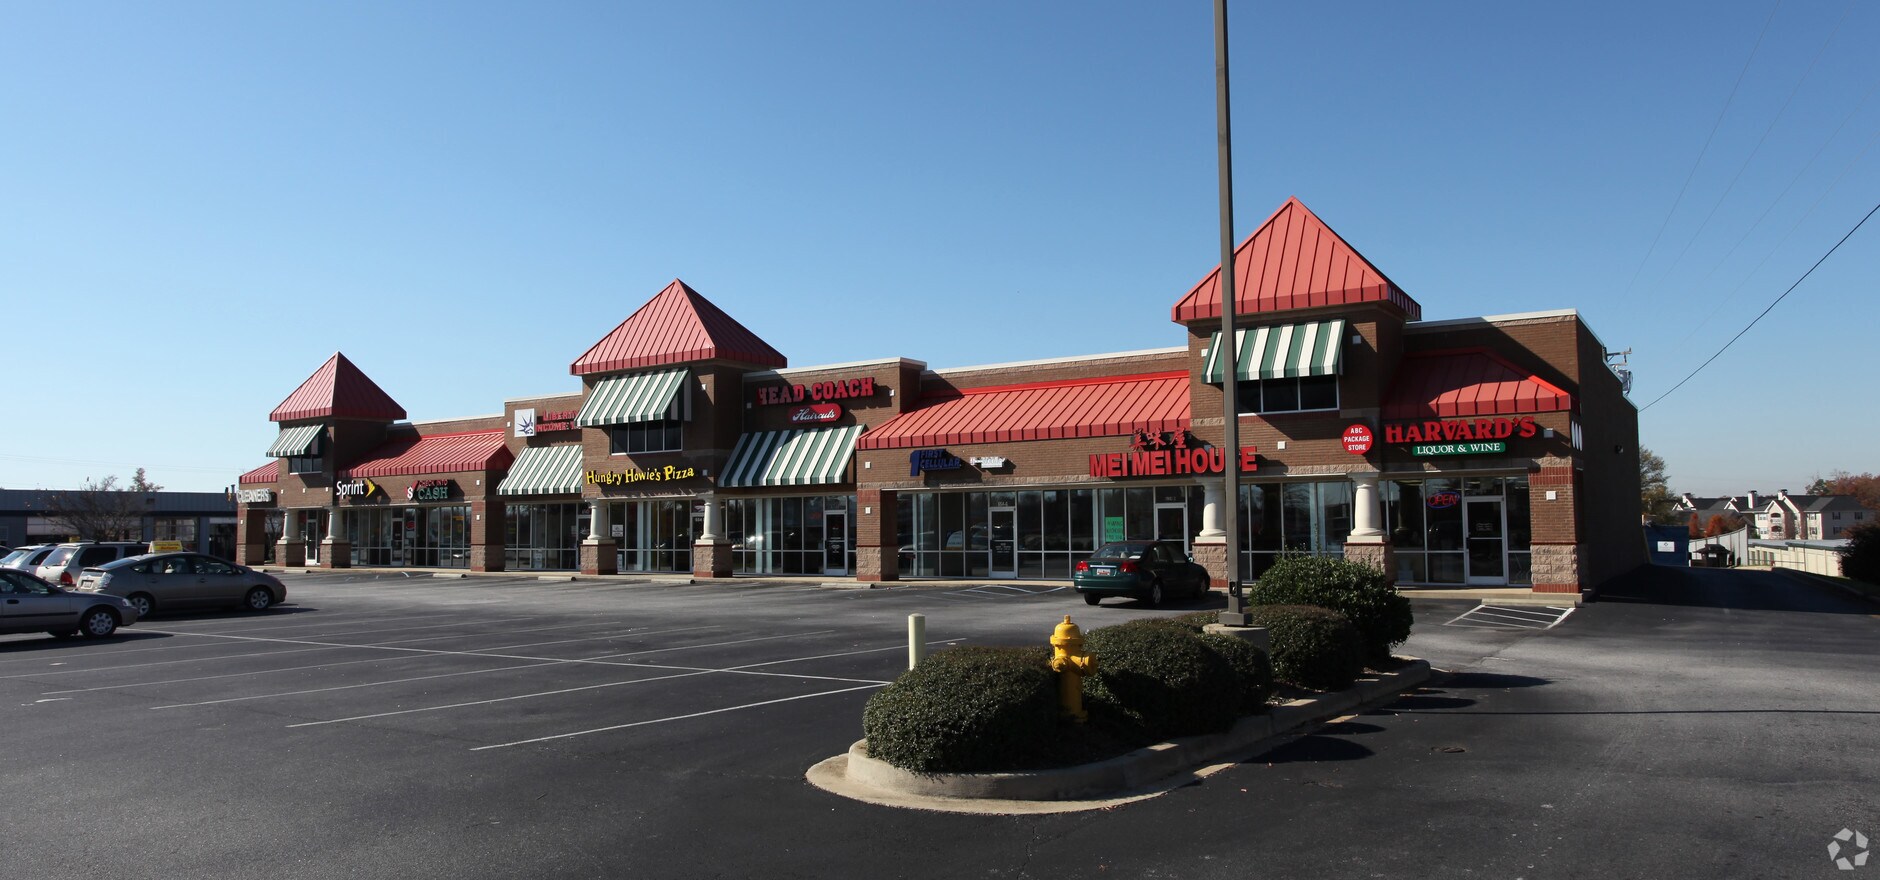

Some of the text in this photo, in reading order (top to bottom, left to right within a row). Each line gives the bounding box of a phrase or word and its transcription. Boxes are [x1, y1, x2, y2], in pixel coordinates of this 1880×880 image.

[757, 377, 874, 405] HEAD COACH
[792, 408, 836, 422] Haircuts
[1385, 416, 1537, 443] HARVARD'S
[1343, 435, 1370, 443] PACKAGE
[920, 449, 944, 458] FIRST
[1416, 443, 1501, 455] LIQUOR & WINE
[920, 457, 961, 469] CELLULAR
[1089, 446, 1258, 477] MEI MEI HOUE
[586, 465, 694, 485] Hungry Howie's Pizza
[336, 480, 364, 499] Sprint
[1428, 494, 1457, 506] OPEN
